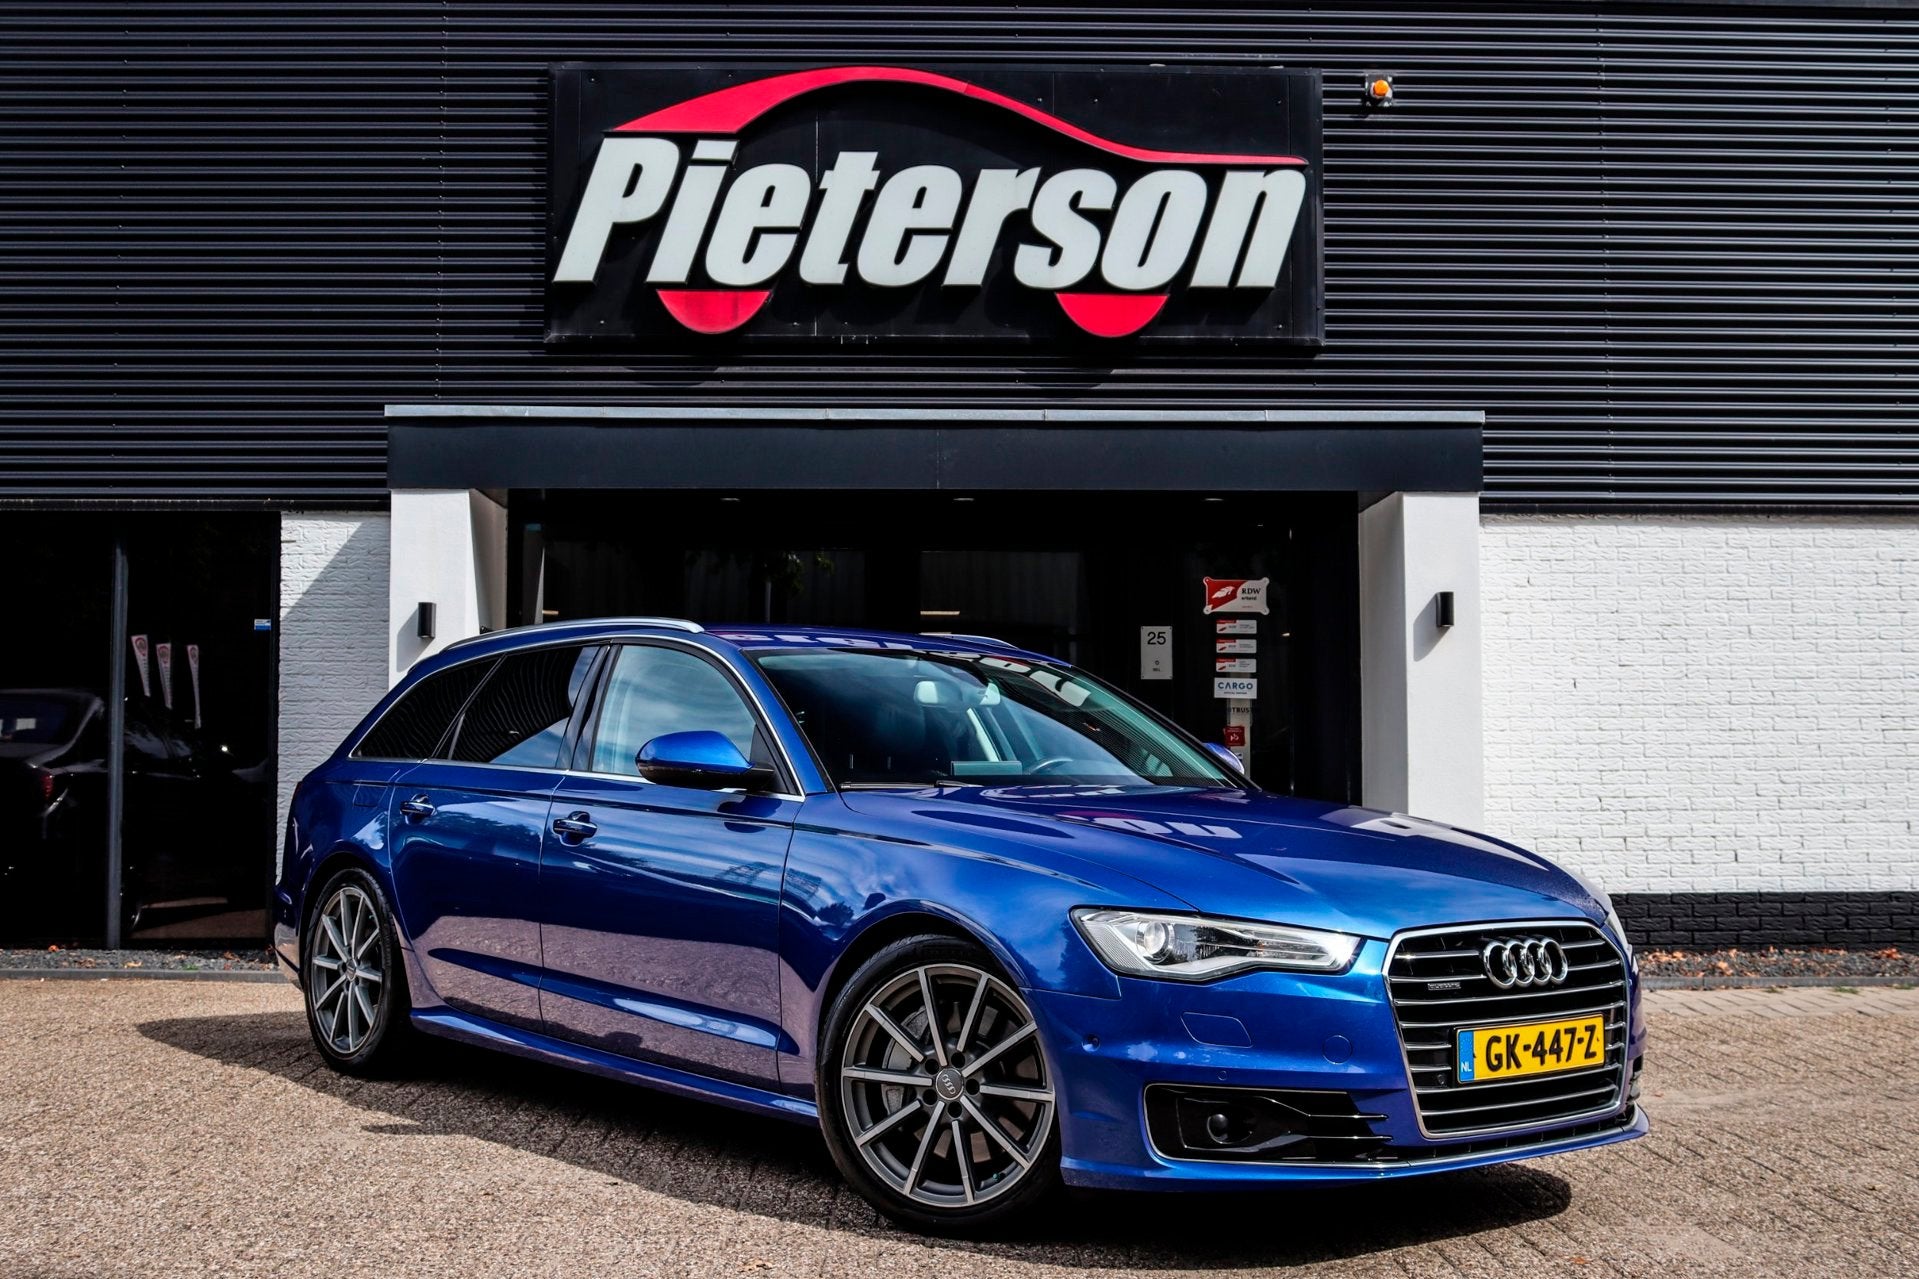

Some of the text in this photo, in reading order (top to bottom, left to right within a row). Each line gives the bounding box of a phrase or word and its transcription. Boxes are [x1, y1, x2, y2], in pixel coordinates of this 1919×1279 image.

[554, 137, 1307, 289] Pieterson
[1241, 587, 1261, 595] RDW
[1147, 631, 1166, 645] 25
[1217, 682, 1253, 690] CARGO
[1485, 1024, 1597, 1072] GK-447-Z
[1460, 1062, 1473, 1073] NL
